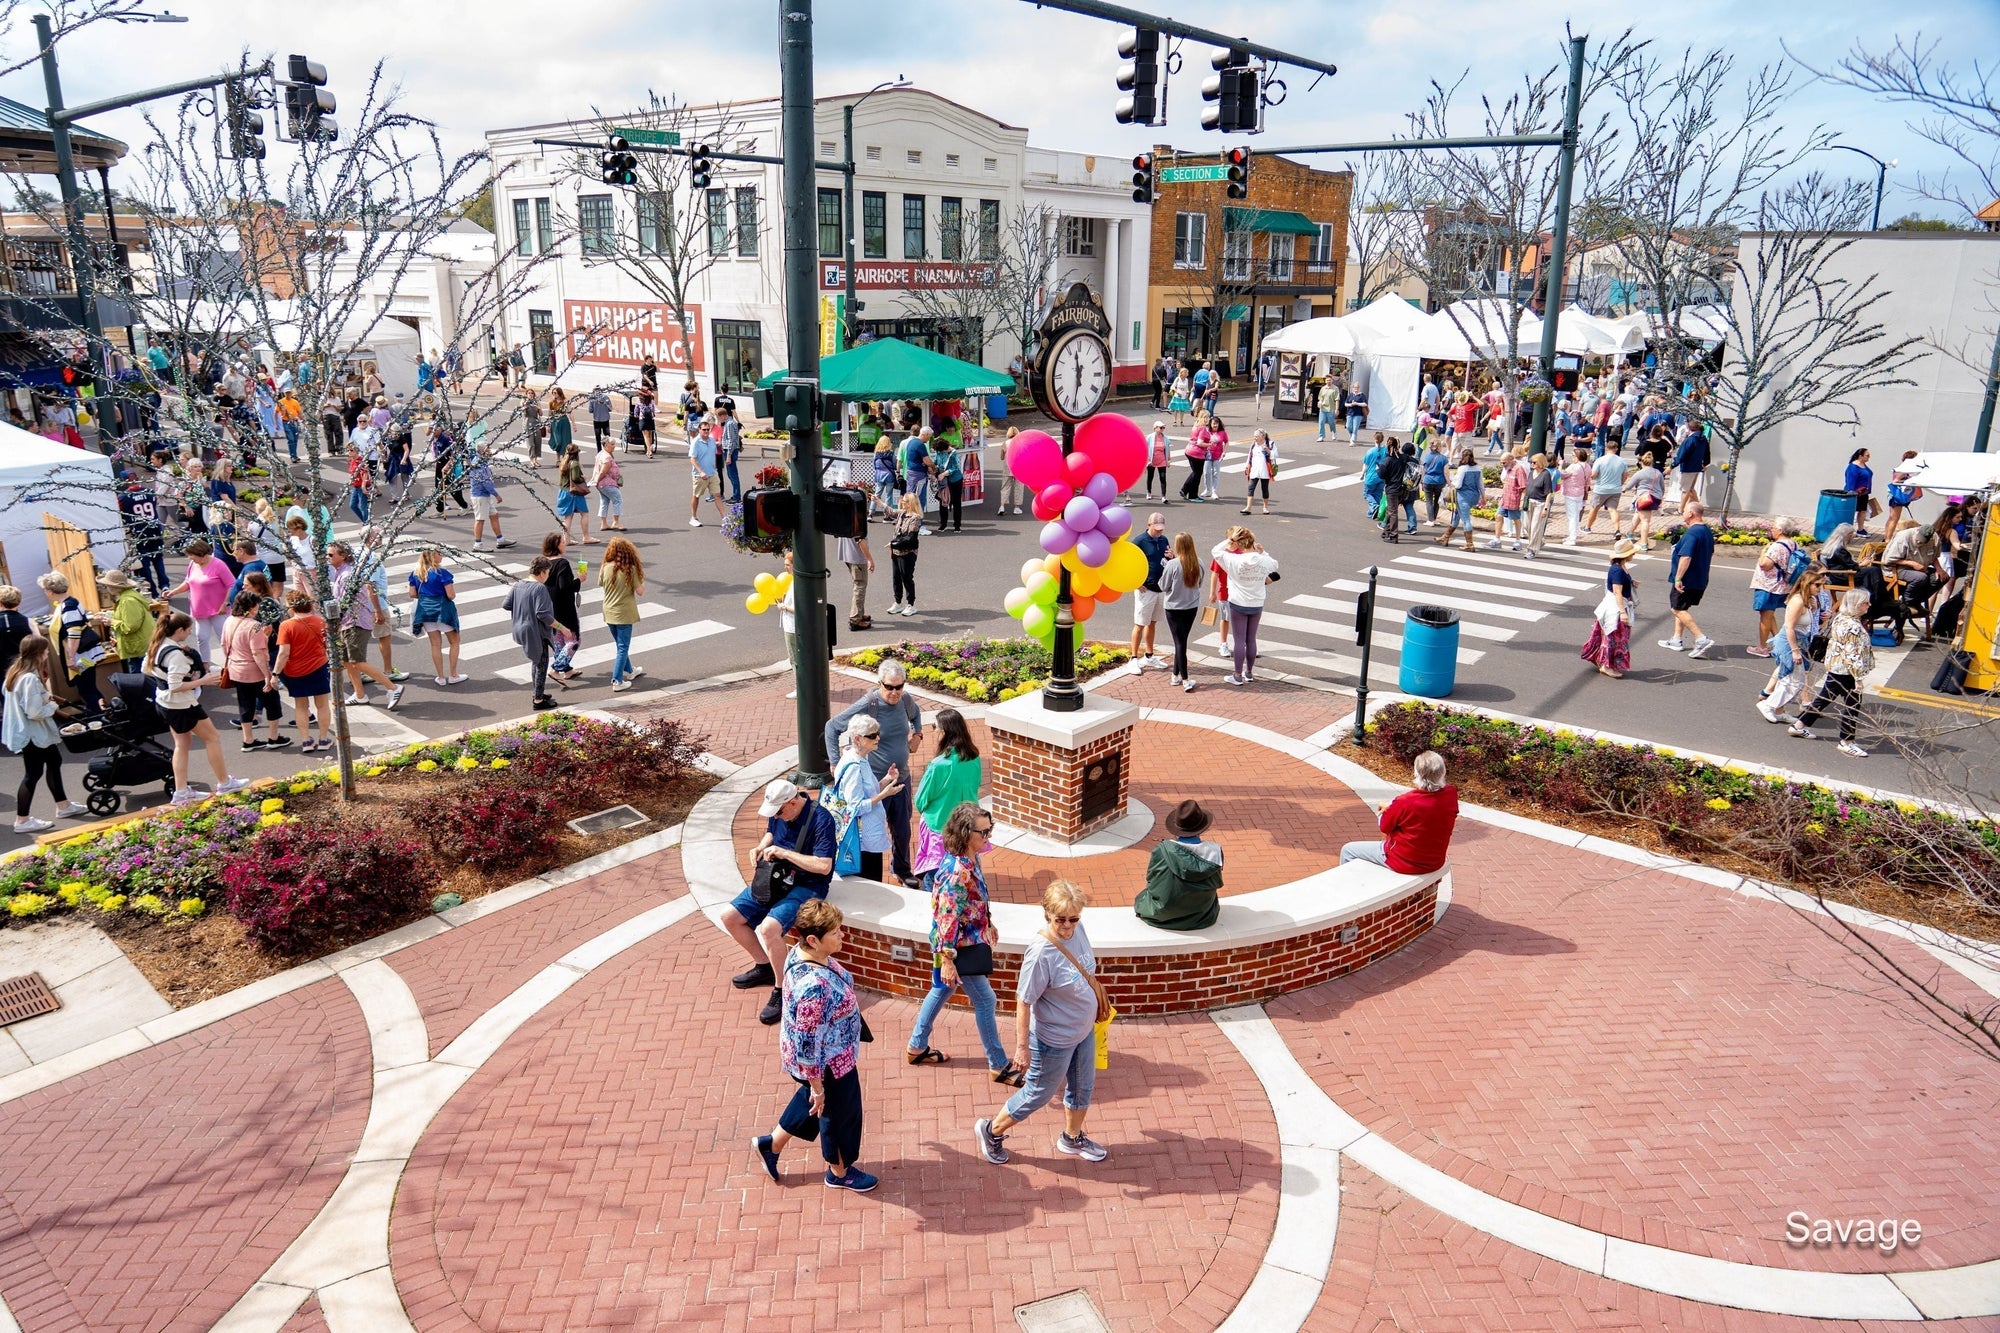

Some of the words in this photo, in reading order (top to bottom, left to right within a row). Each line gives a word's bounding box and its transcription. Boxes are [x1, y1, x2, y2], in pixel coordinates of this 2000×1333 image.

[615, 129, 657, 143] FAIRHOPE
[664, 133, 679, 144] AVE
[1162, 170, 1168, 181] S
[1173, 168, 1212, 180] SECTION
[1217, 167, 1230, 179] ST
[571, 305, 664, 333] FAIRHOPE
[1051, 307, 1101, 331] FAIRHOPE
[133, 502, 155, 519] 99
